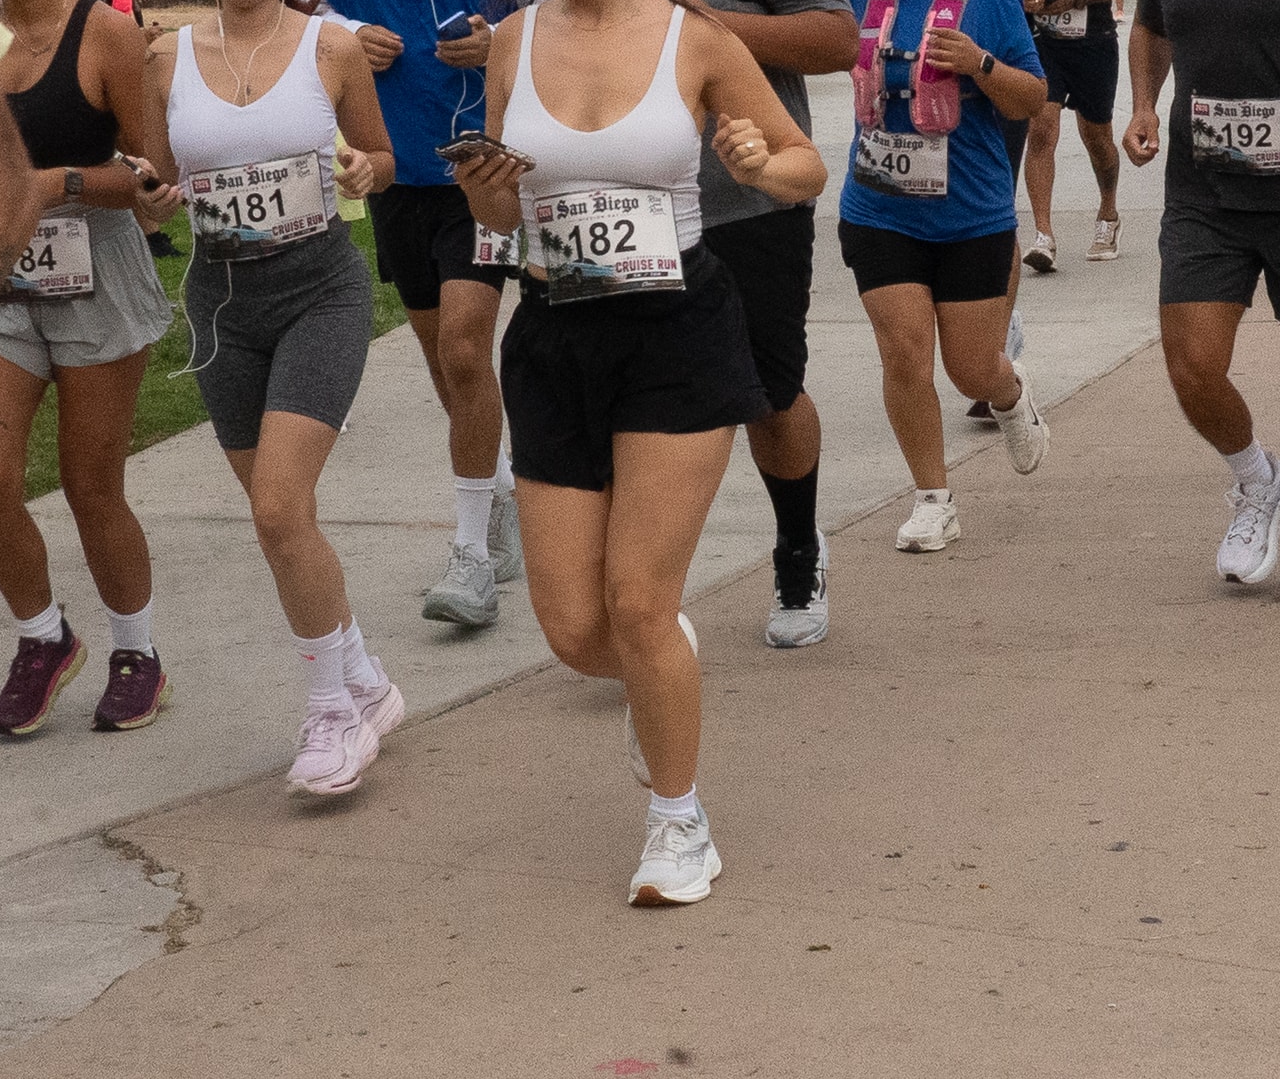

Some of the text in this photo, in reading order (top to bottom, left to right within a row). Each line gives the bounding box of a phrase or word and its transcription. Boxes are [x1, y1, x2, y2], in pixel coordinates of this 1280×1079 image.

[1213, 103, 1238, 117] San
[1241, 105, 1275, 119] Diego
[872, 131, 924, 150] San Diego
[1221, 123, 1272, 148] 192
[881, 153, 911, 175] 40
[215, 173, 244, 191] San
[246, 167, 289, 186] Diego
[227, 188, 285, 228] 181
[556, 199, 588, 220] San
[593, 196, 639, 216] Diego
[272, 214, 324, 237] CRUISE RUN
[570, 219, 637, 261] 182
[615, 259, 677, 273] CRUISE RUN
[40, 274, 90, 288] CRUISE RUN
